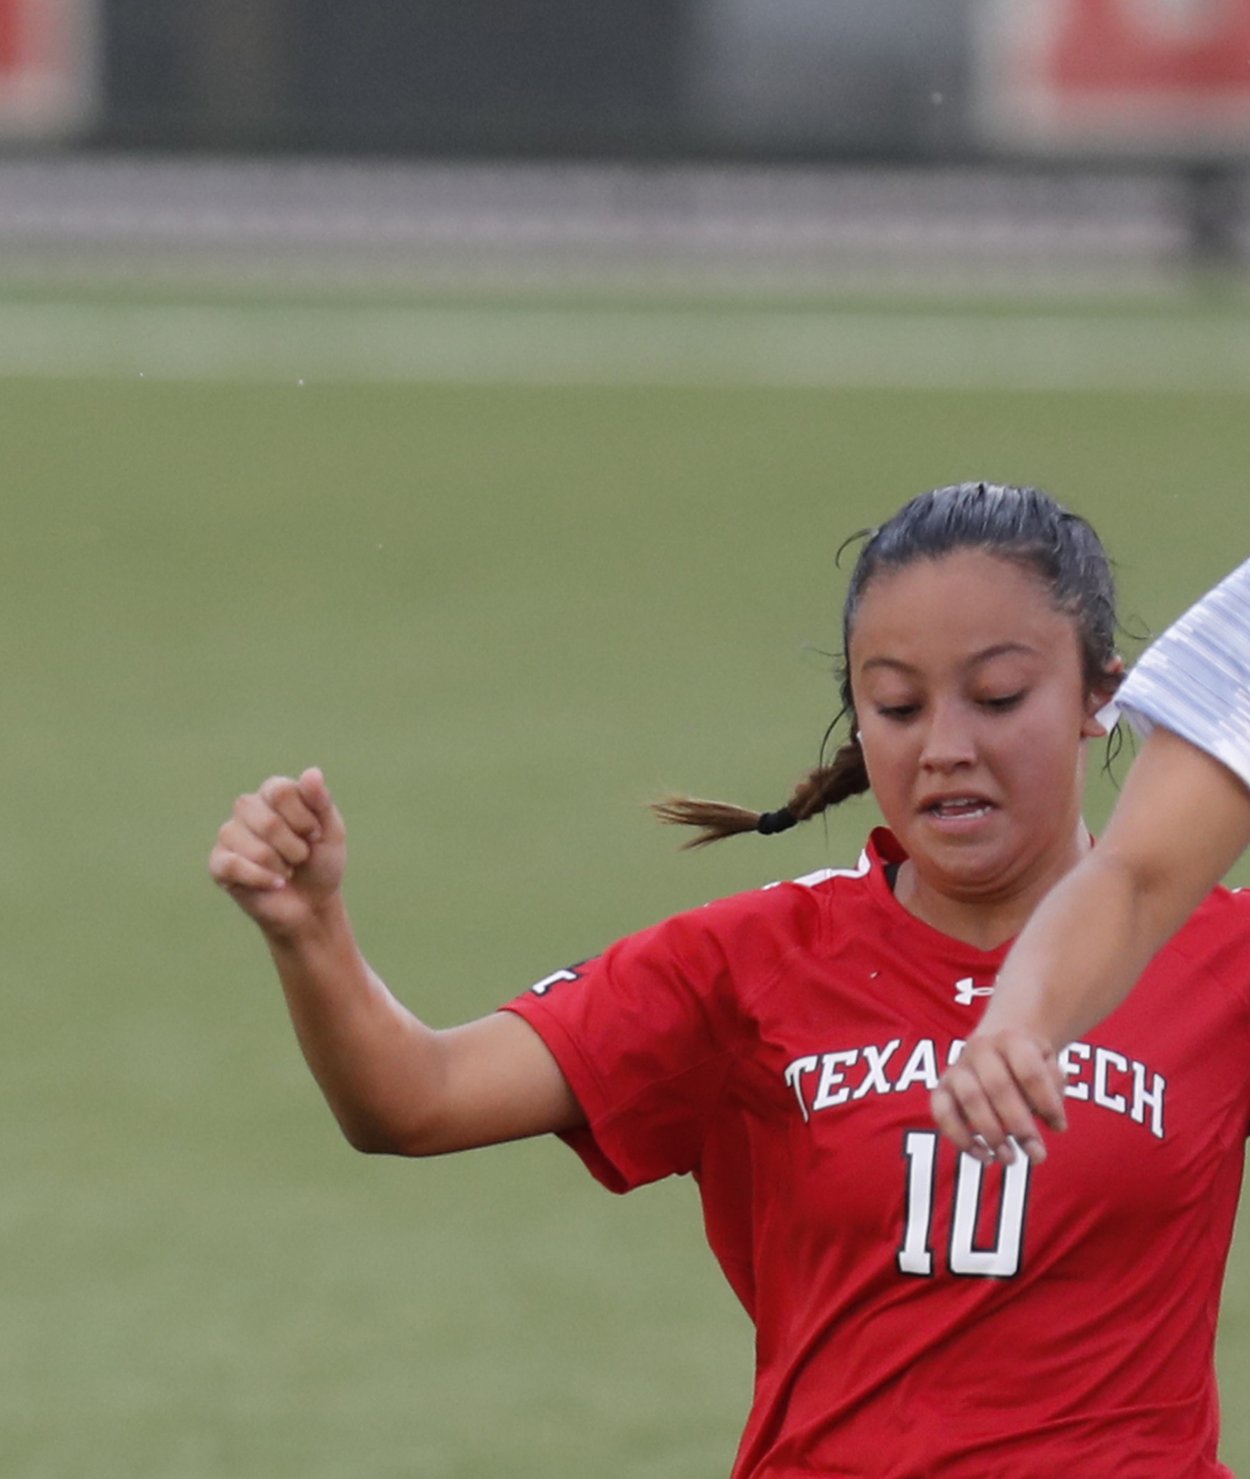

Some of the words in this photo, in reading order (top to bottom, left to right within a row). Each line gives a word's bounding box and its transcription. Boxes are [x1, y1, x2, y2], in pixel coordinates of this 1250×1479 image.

[784, 1038, 967, 1123] TEXA
[1058, 1041, 1166, 1140] ECH
[897, 1129, 1033, 1278] 10
